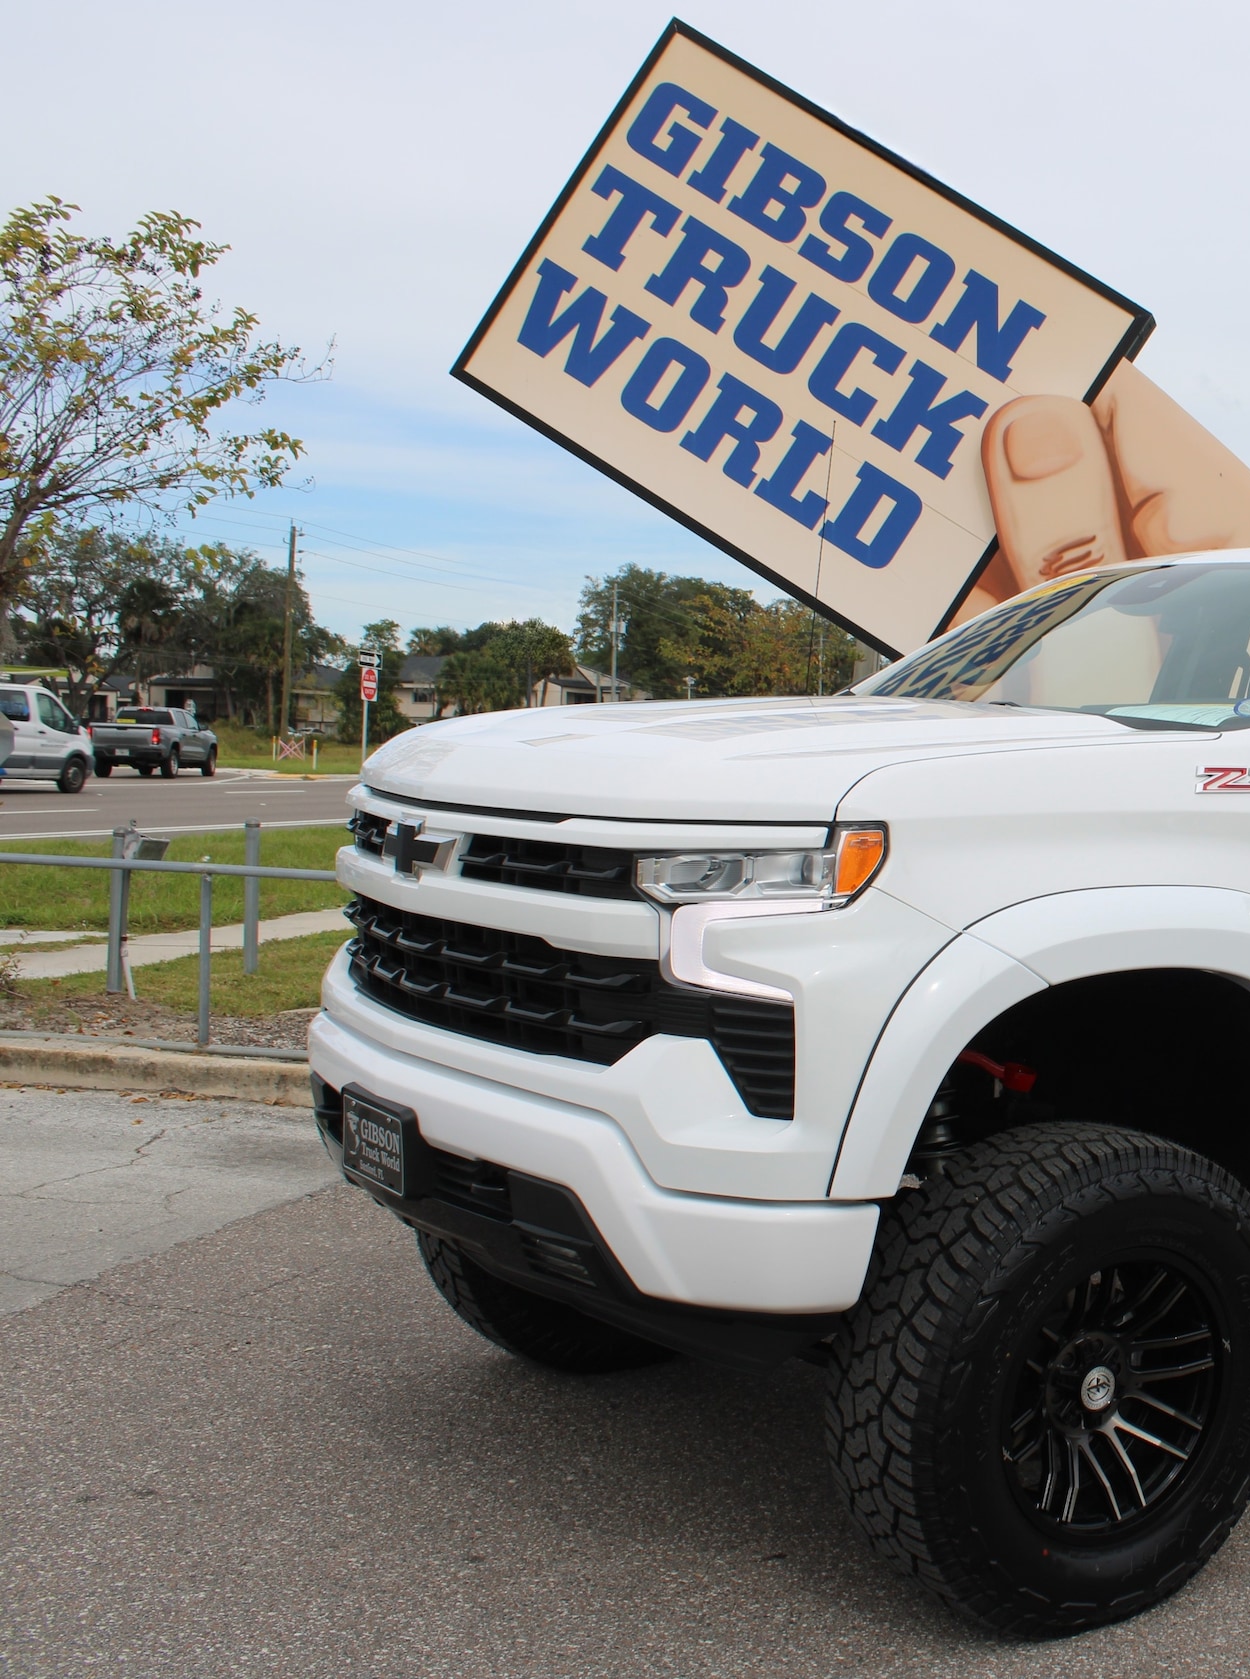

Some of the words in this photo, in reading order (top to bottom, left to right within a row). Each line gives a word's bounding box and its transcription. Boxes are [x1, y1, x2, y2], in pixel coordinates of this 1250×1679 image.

[581, 164, 989, 480] TRUCK
[626, 82, 1046, 384] GIBSON
[516, 257, 923, 569] WORLD
[360, 1118, 400, 1154] GIBSON
[361, 1141, 380, 1162] Truck
[381, 1150, 400, 1172] World
